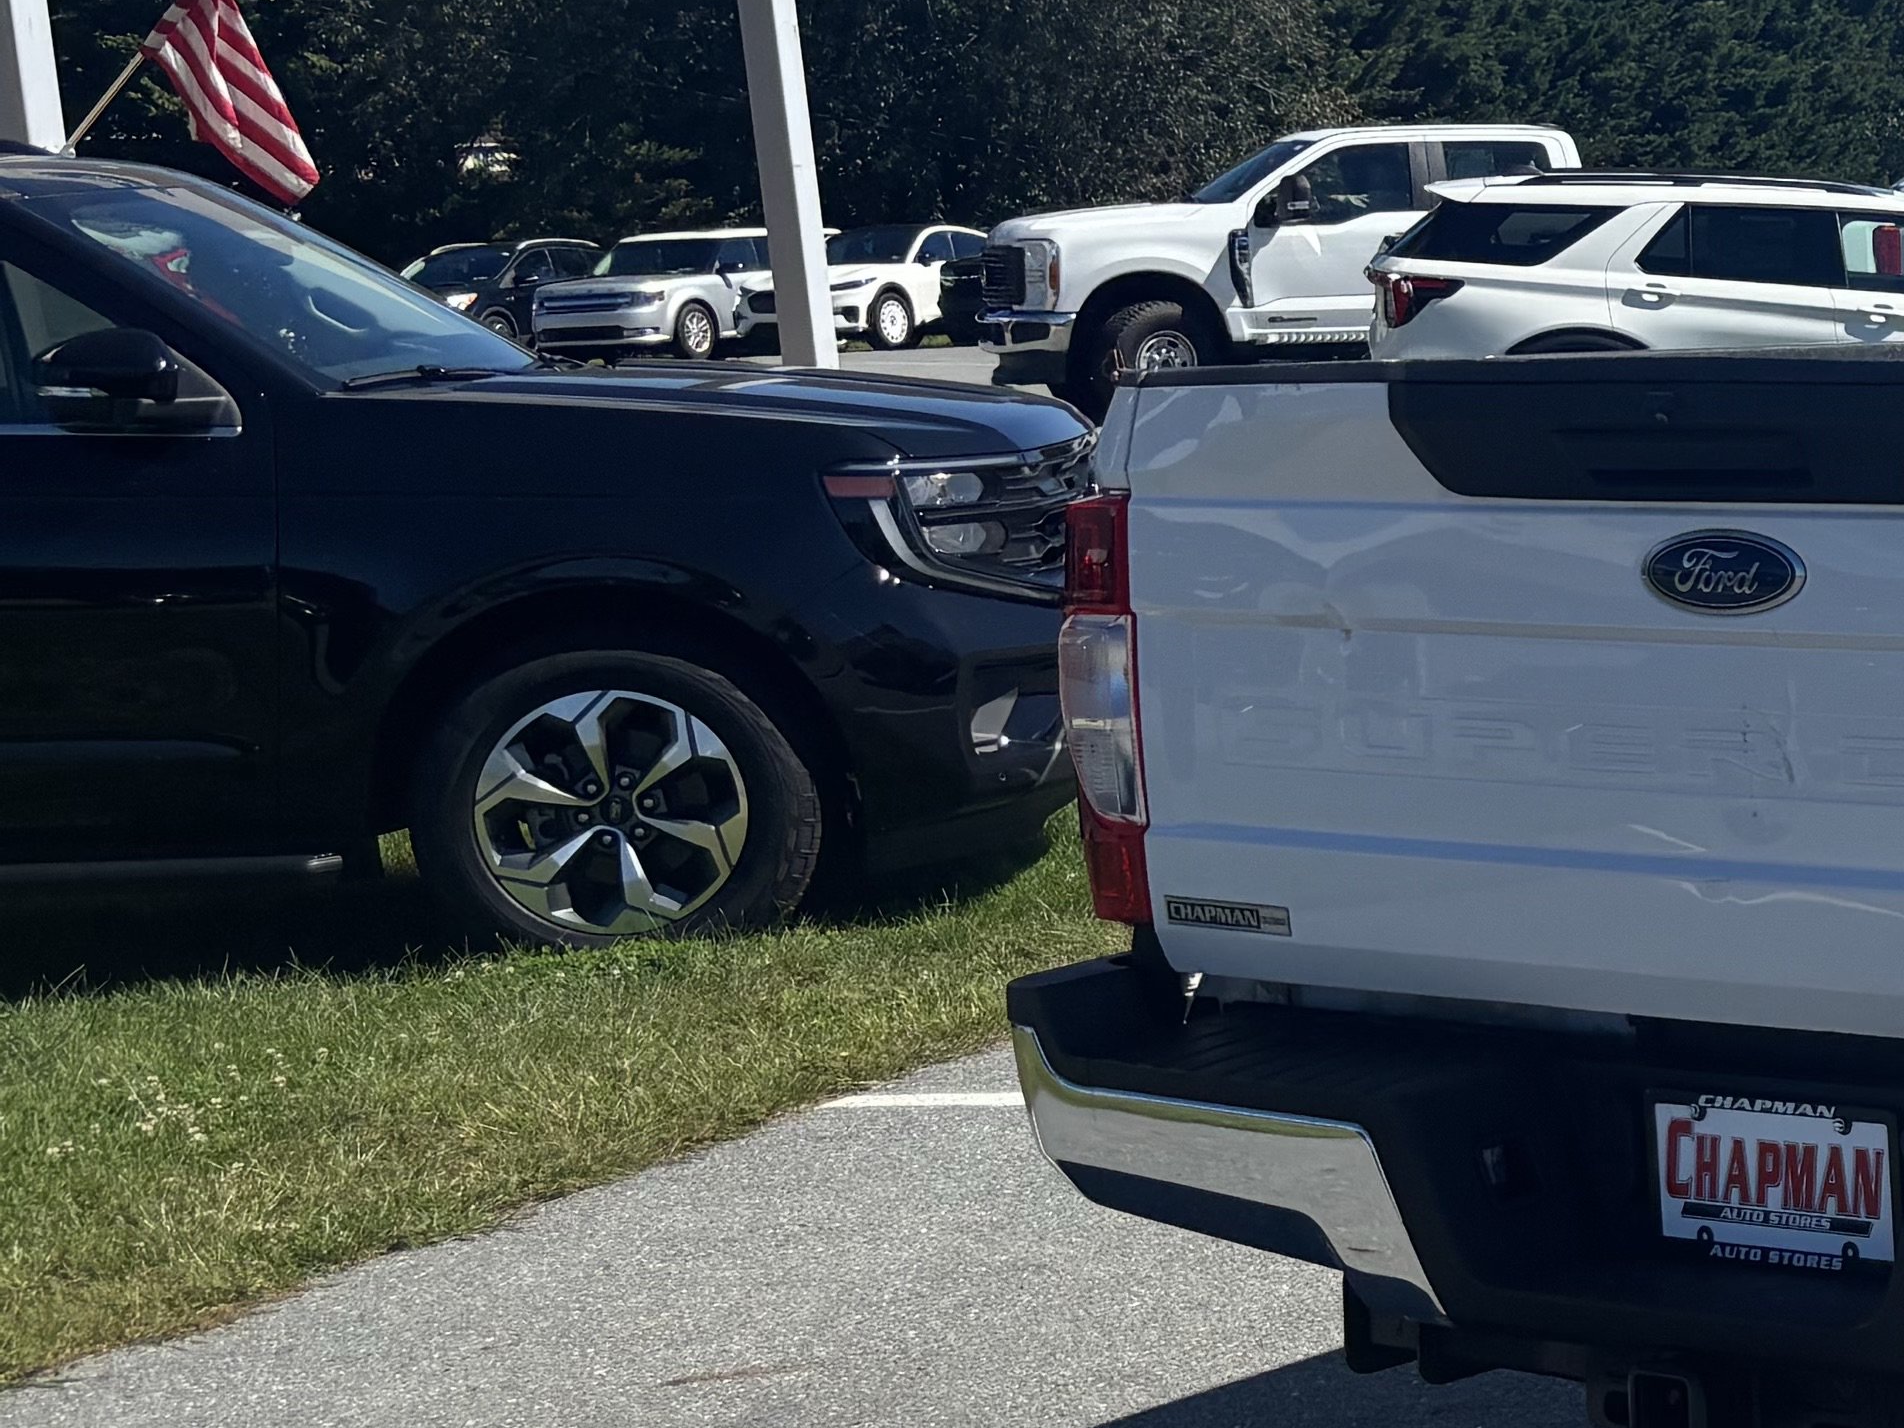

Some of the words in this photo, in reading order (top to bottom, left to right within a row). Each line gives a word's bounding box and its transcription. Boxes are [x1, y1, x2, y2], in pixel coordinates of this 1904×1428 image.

[1674, 548, 1761, 594] Ford
[1222, 702, 1796, 784] SUPER
[1170, 903, 1259, 927] CHAPMAN
[1698, 1094, 1836, 1118] CHAPMAN
[1666, 1118, 1884, 1219] CHAPMAN
[1719, 1207, 1764, 1222] AUTO
[1768, 1214, 1831, 1230] STORES
[1709, 1244, 1762, 1261] AUTO
[1767, 1252, 1843, 1270] STORES
